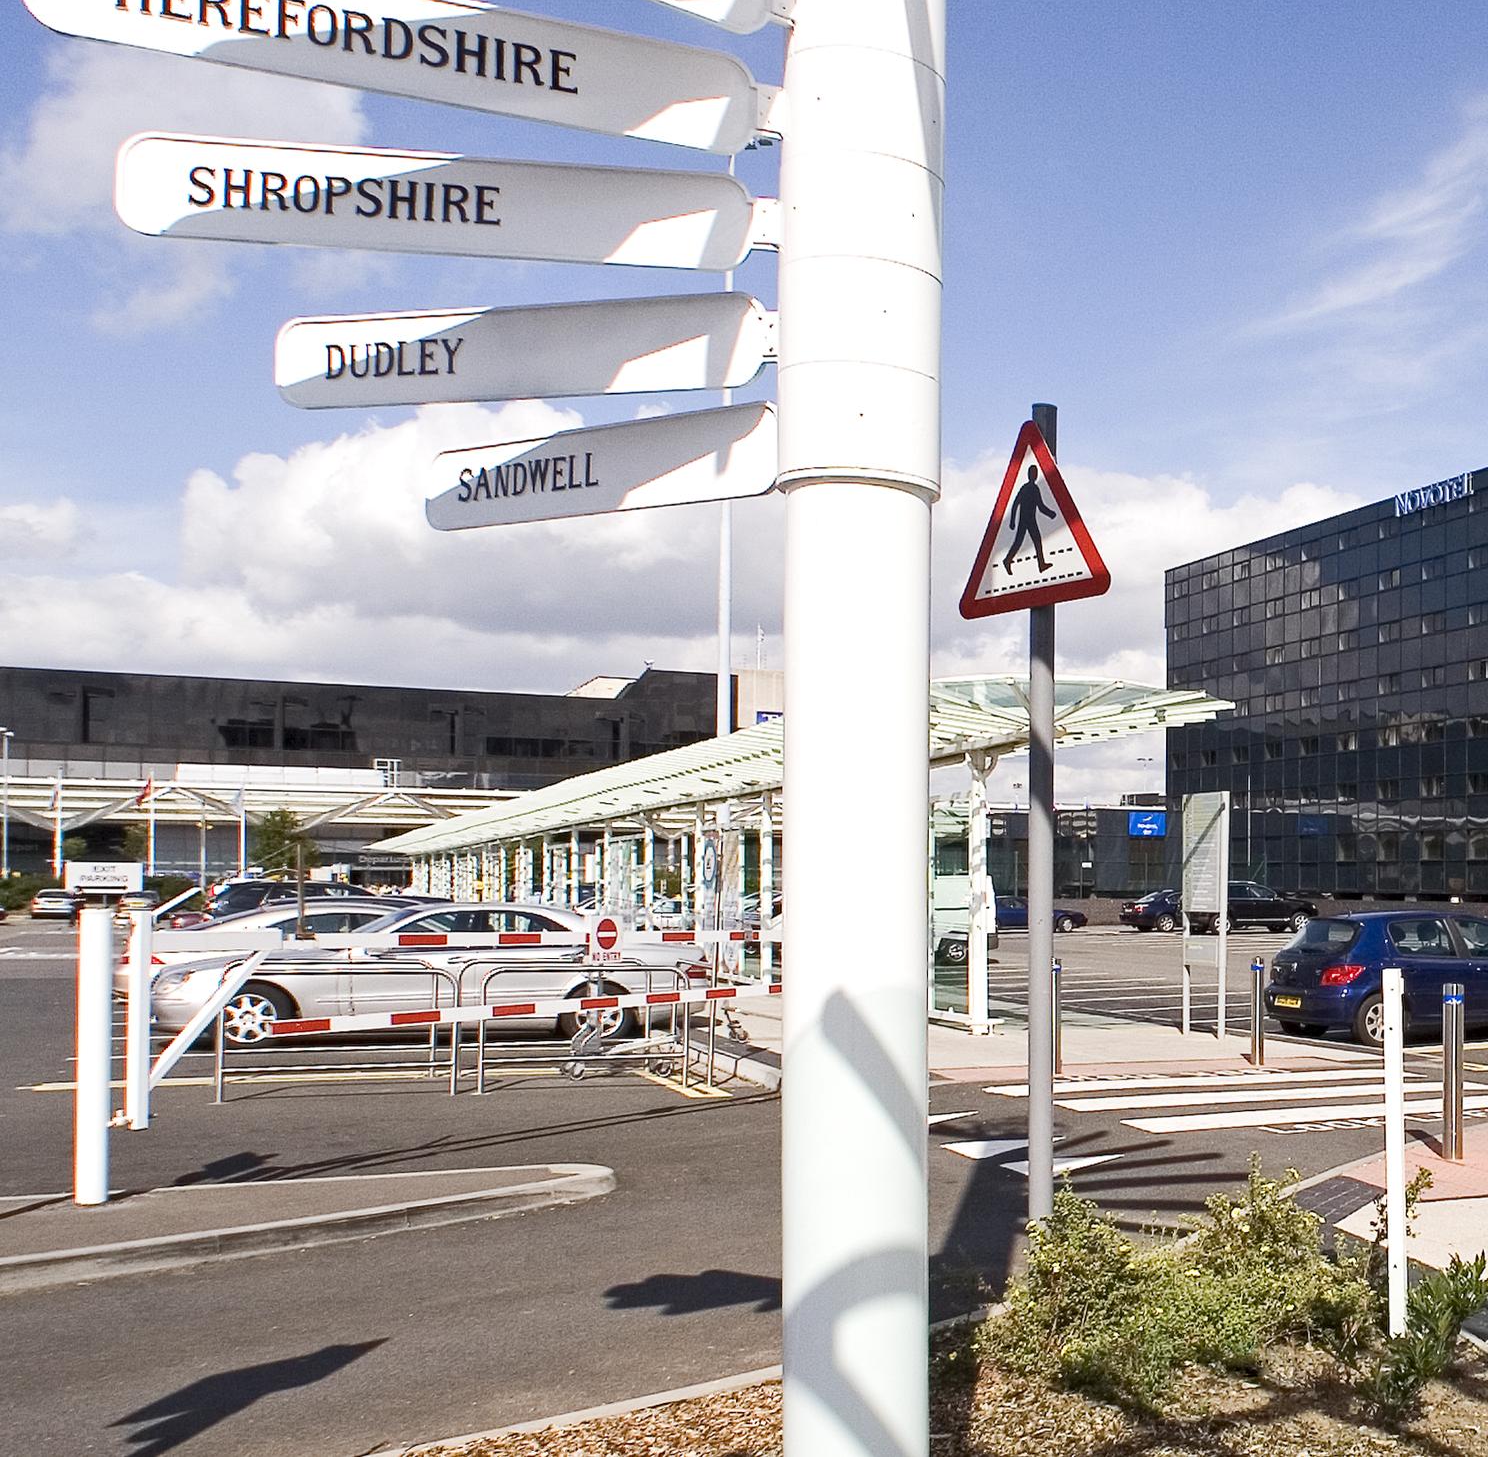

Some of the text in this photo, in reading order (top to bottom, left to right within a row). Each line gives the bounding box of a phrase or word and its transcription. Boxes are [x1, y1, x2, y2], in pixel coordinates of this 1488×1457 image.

[187, 165, 502, 227] SHROPSHIRE
[325, 337, 464, 380] DUDLEY
[457, 452, 600, 504] SANDWELL
